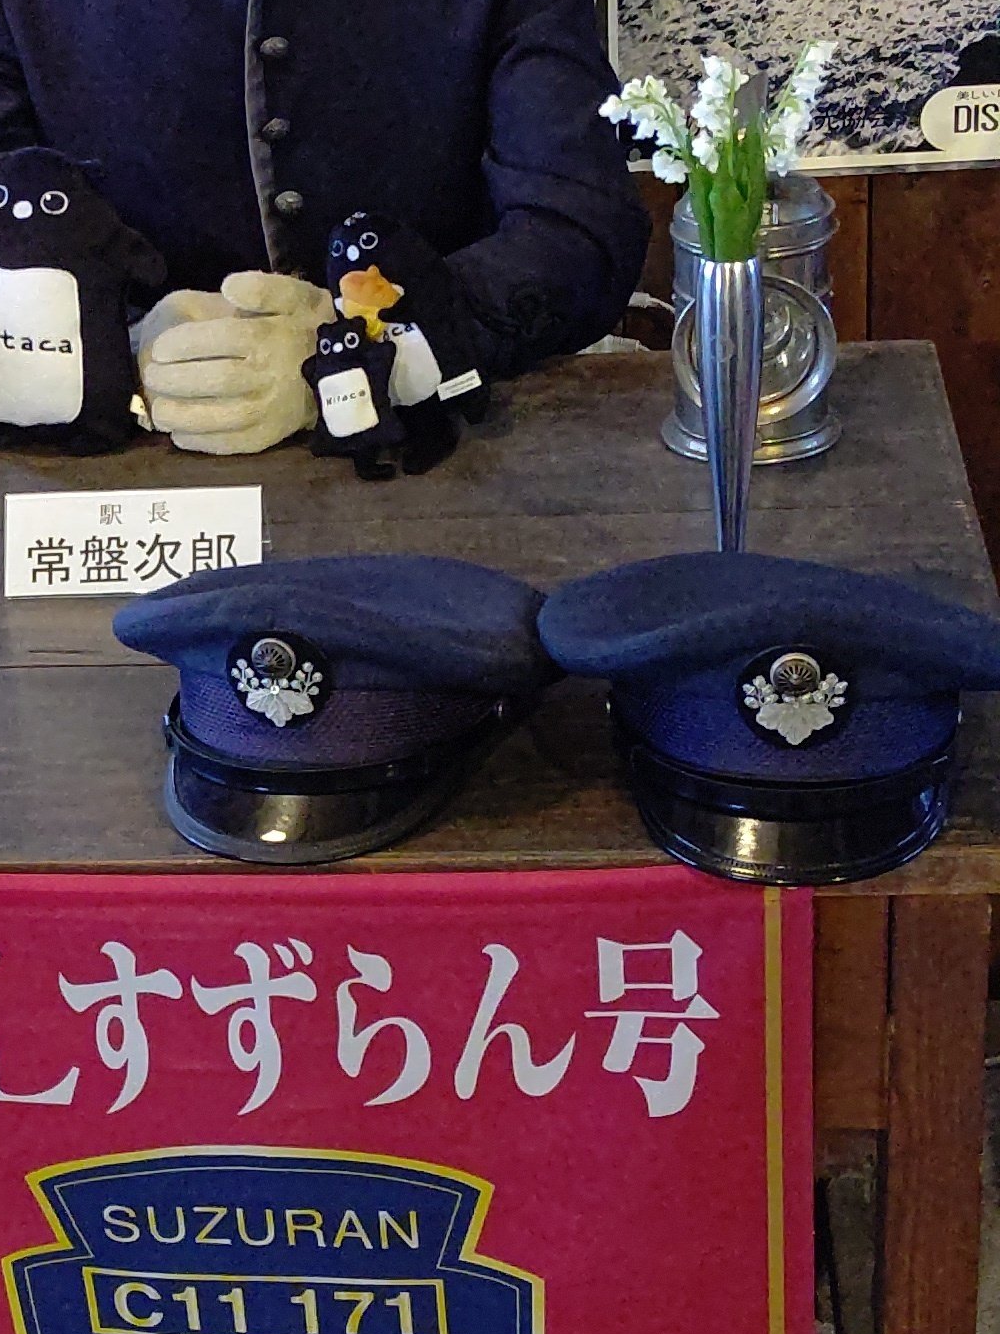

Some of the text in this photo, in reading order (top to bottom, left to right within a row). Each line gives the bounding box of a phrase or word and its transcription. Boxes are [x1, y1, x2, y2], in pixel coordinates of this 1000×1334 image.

[954, 103, 1000, 134] DIS
[28, 532, 238, 586] 常盤次郎
[102, 1204, 420, 1251] SUZURAN
[114, 1281, 248, 1334] C11
